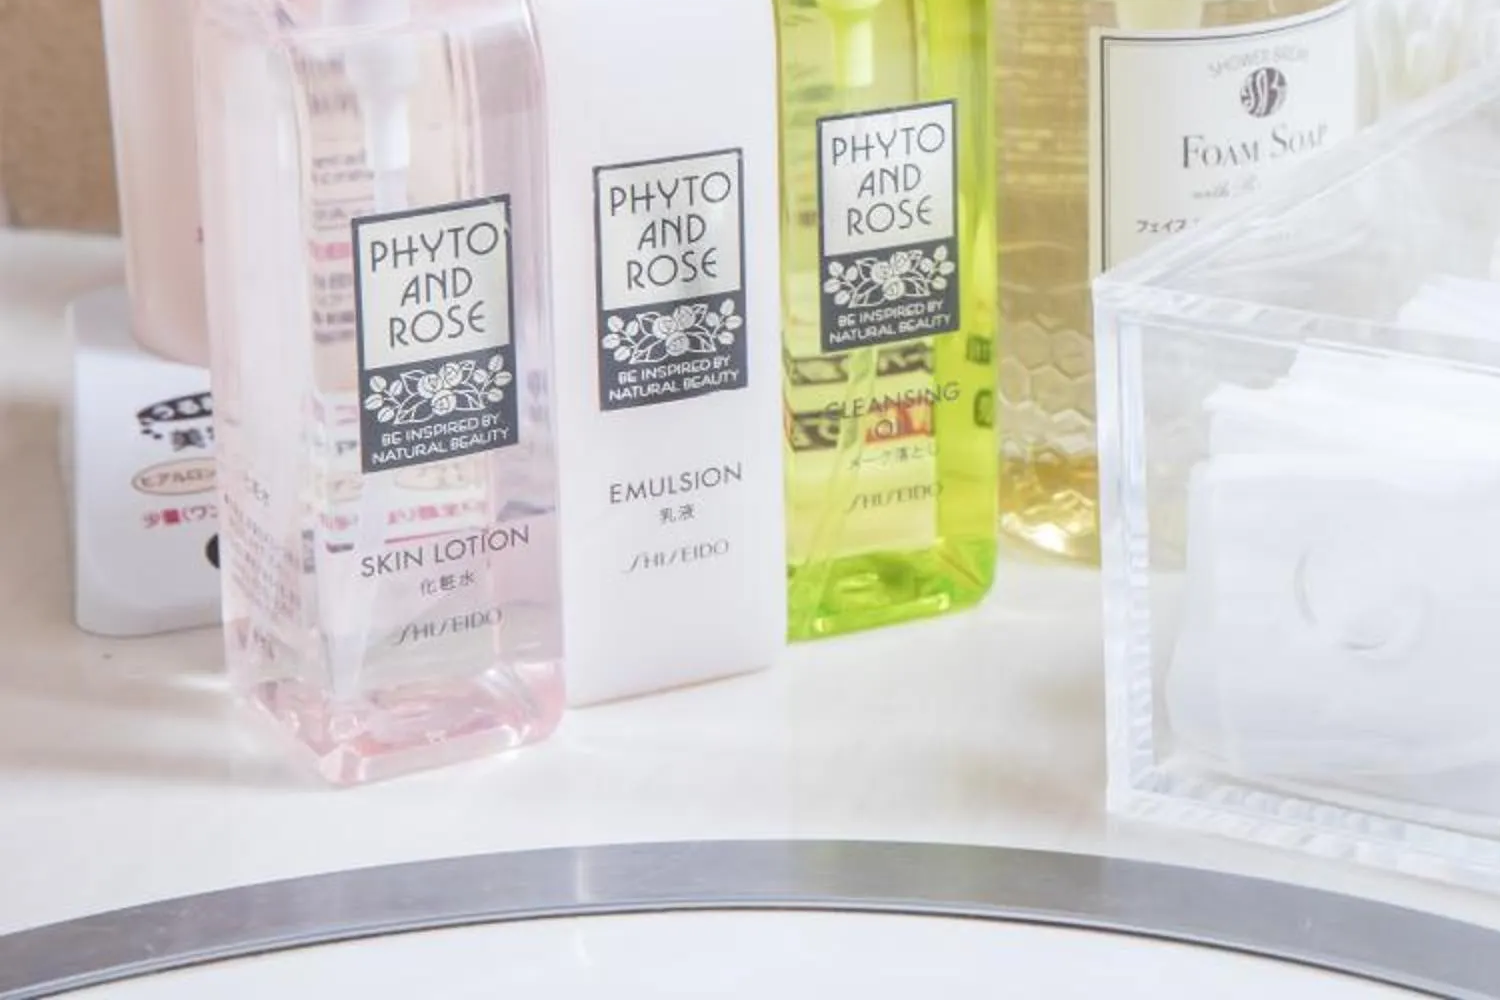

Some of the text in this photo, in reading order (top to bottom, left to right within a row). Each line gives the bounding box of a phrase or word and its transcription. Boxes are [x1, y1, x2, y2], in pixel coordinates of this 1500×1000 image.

[831, 122, 946, 166] PHYTO
[1183, 133, 1259, 169] FOAM
[609, 171, 732, 217] PHYTO
[857, 162, 922, 199] AND
[637, 213, 707, 251] AND
[847, 194, 932, 237] ROSE
[370, 221, 499, 273] PHYTO
[400, 266, 473, 307] AND
[626, 247, 718, 290] ROSE
[388, 299, 486, 349] ROSE
[829, 313, 951, 344] NATURAL BEAUTY
[838, 300, 944, 328] BE INSPIRED BY
[608, 369, 740, 402] NATURAL BEAUTY
[617, 354, 731, 385] BE INSPIRED BY
[825, 381, 963, 422] CLEANSING
[371, 427, 509, 466] NATURAL BEAUTY
[381, 413, 500, 447] BE INSPIRED BY
[609, 461, 742, 504] EMULSION
[659, 503, 696, 525] 乳液
[360, 524, 530, 578] SKIN LOTION
[620, 538, 730, 574] SHISEIDO
[420, 569, 476, 596] 化粧水
[392, 607, 503, 646] SHISEIDO
